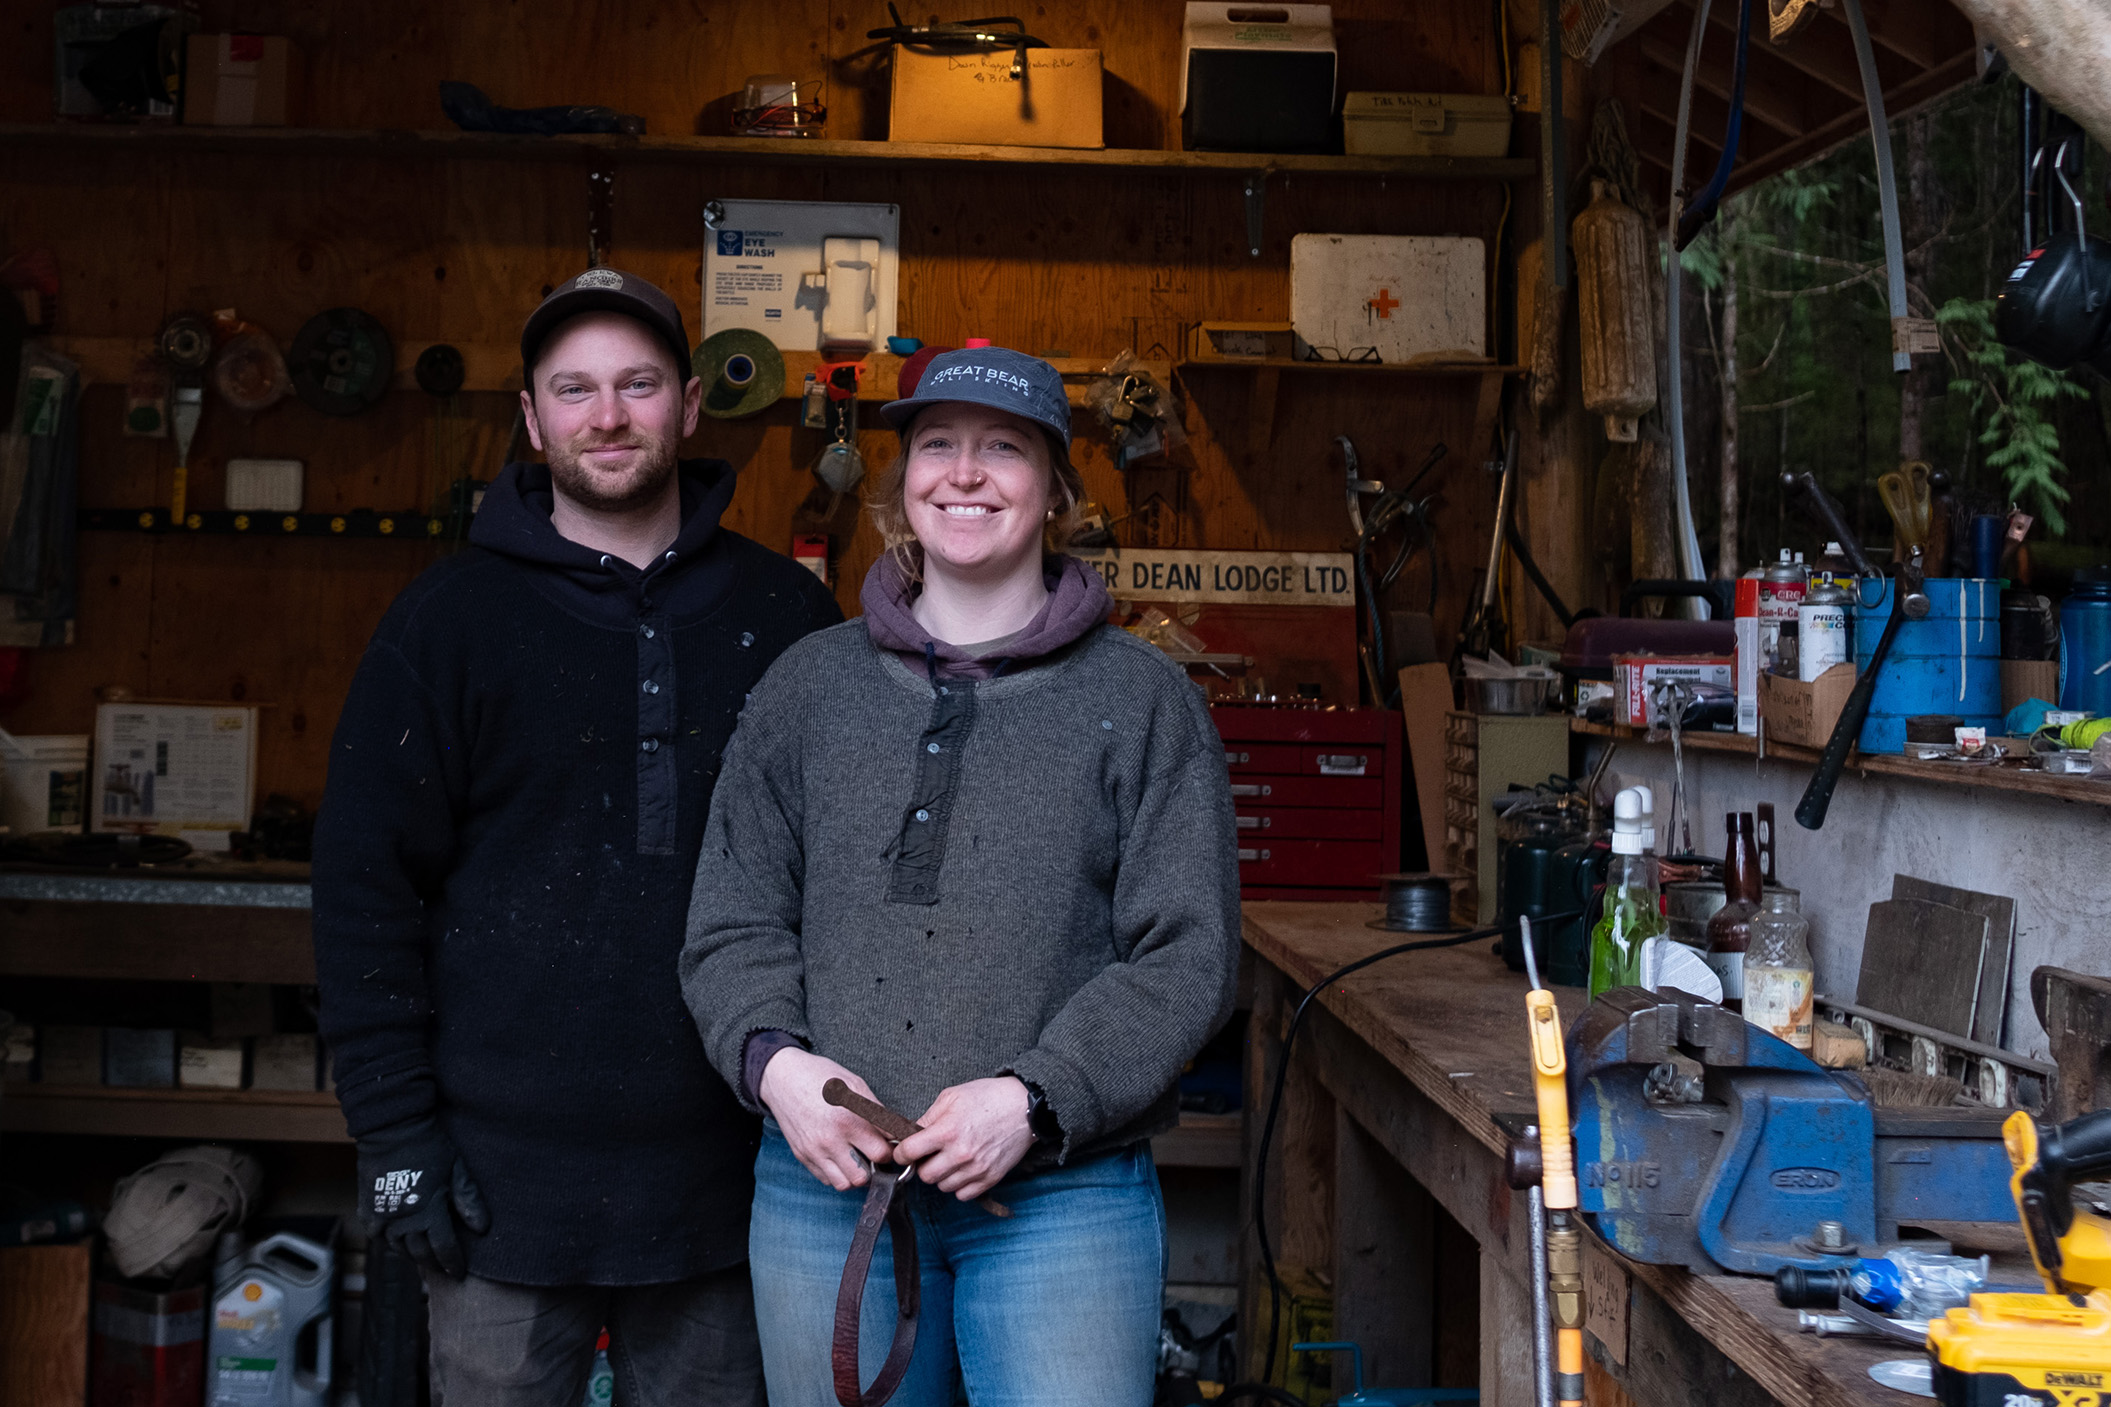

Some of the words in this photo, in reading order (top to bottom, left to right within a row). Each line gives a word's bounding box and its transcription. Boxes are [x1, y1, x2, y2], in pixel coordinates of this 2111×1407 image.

[744, 238, 766, 247] EYE
[744, 248, 775, 257] WASH
[934, 365, 984, 380] GREAT
[986, 367, 1029, 391] BEAR
[975, 376, 1029, 397] SKIING
[1132, 562, 1201, 591] DEAN
[1214, 563, 1293, 593] LODGE
[1304, 565, 1350, 594] LTD.
[1777, 589, 1801, 600] CRC
[1656, 667, 1701, 676] Replacement
[1632, 665, 1641, 717] FILL-RITE
[375, 1170, 423, 1191] DENY
[1775, 1172, 1835, 1188] ERON
